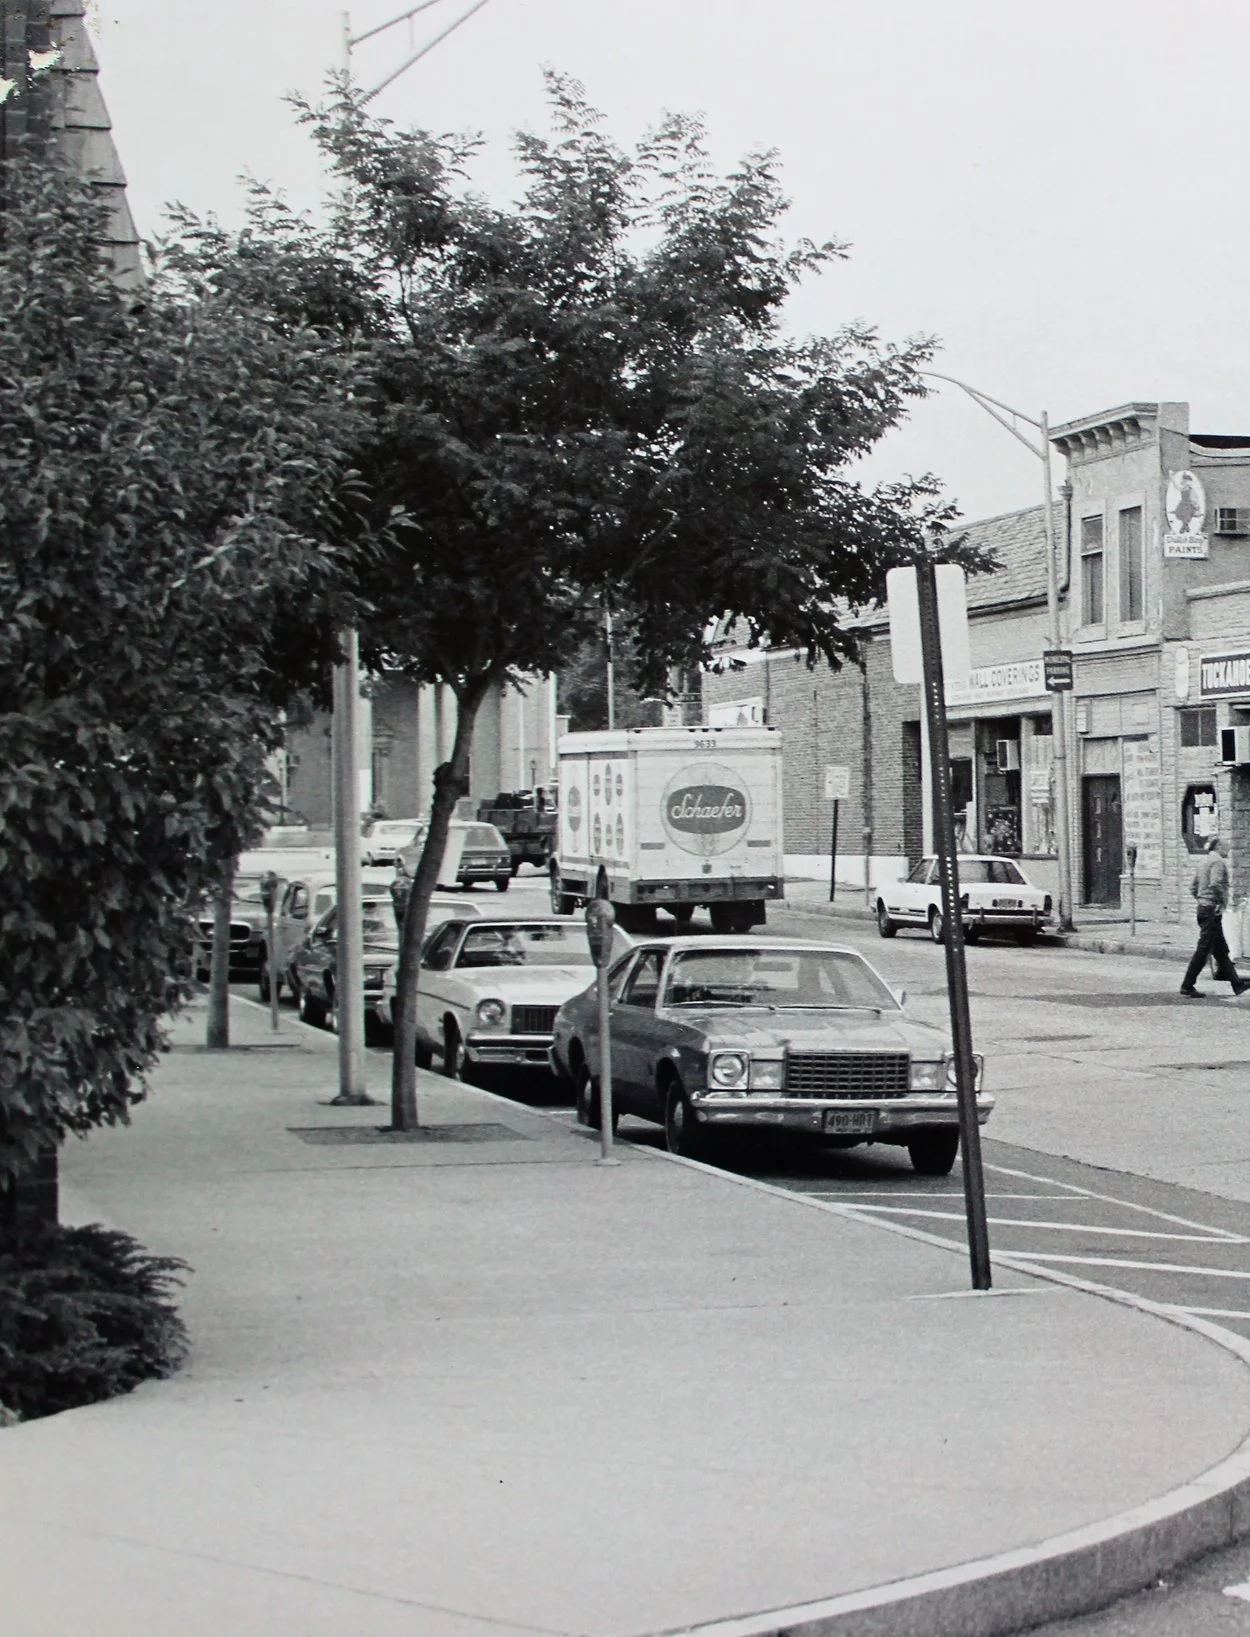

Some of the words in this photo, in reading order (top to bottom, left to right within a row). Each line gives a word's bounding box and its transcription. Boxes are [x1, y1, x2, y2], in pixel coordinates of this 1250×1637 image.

[1169, 546, 1203, 554] PAINTS
[992, 664, 1040, 687] COVERINGS
[671, 793, 743, 820] Schaefer
